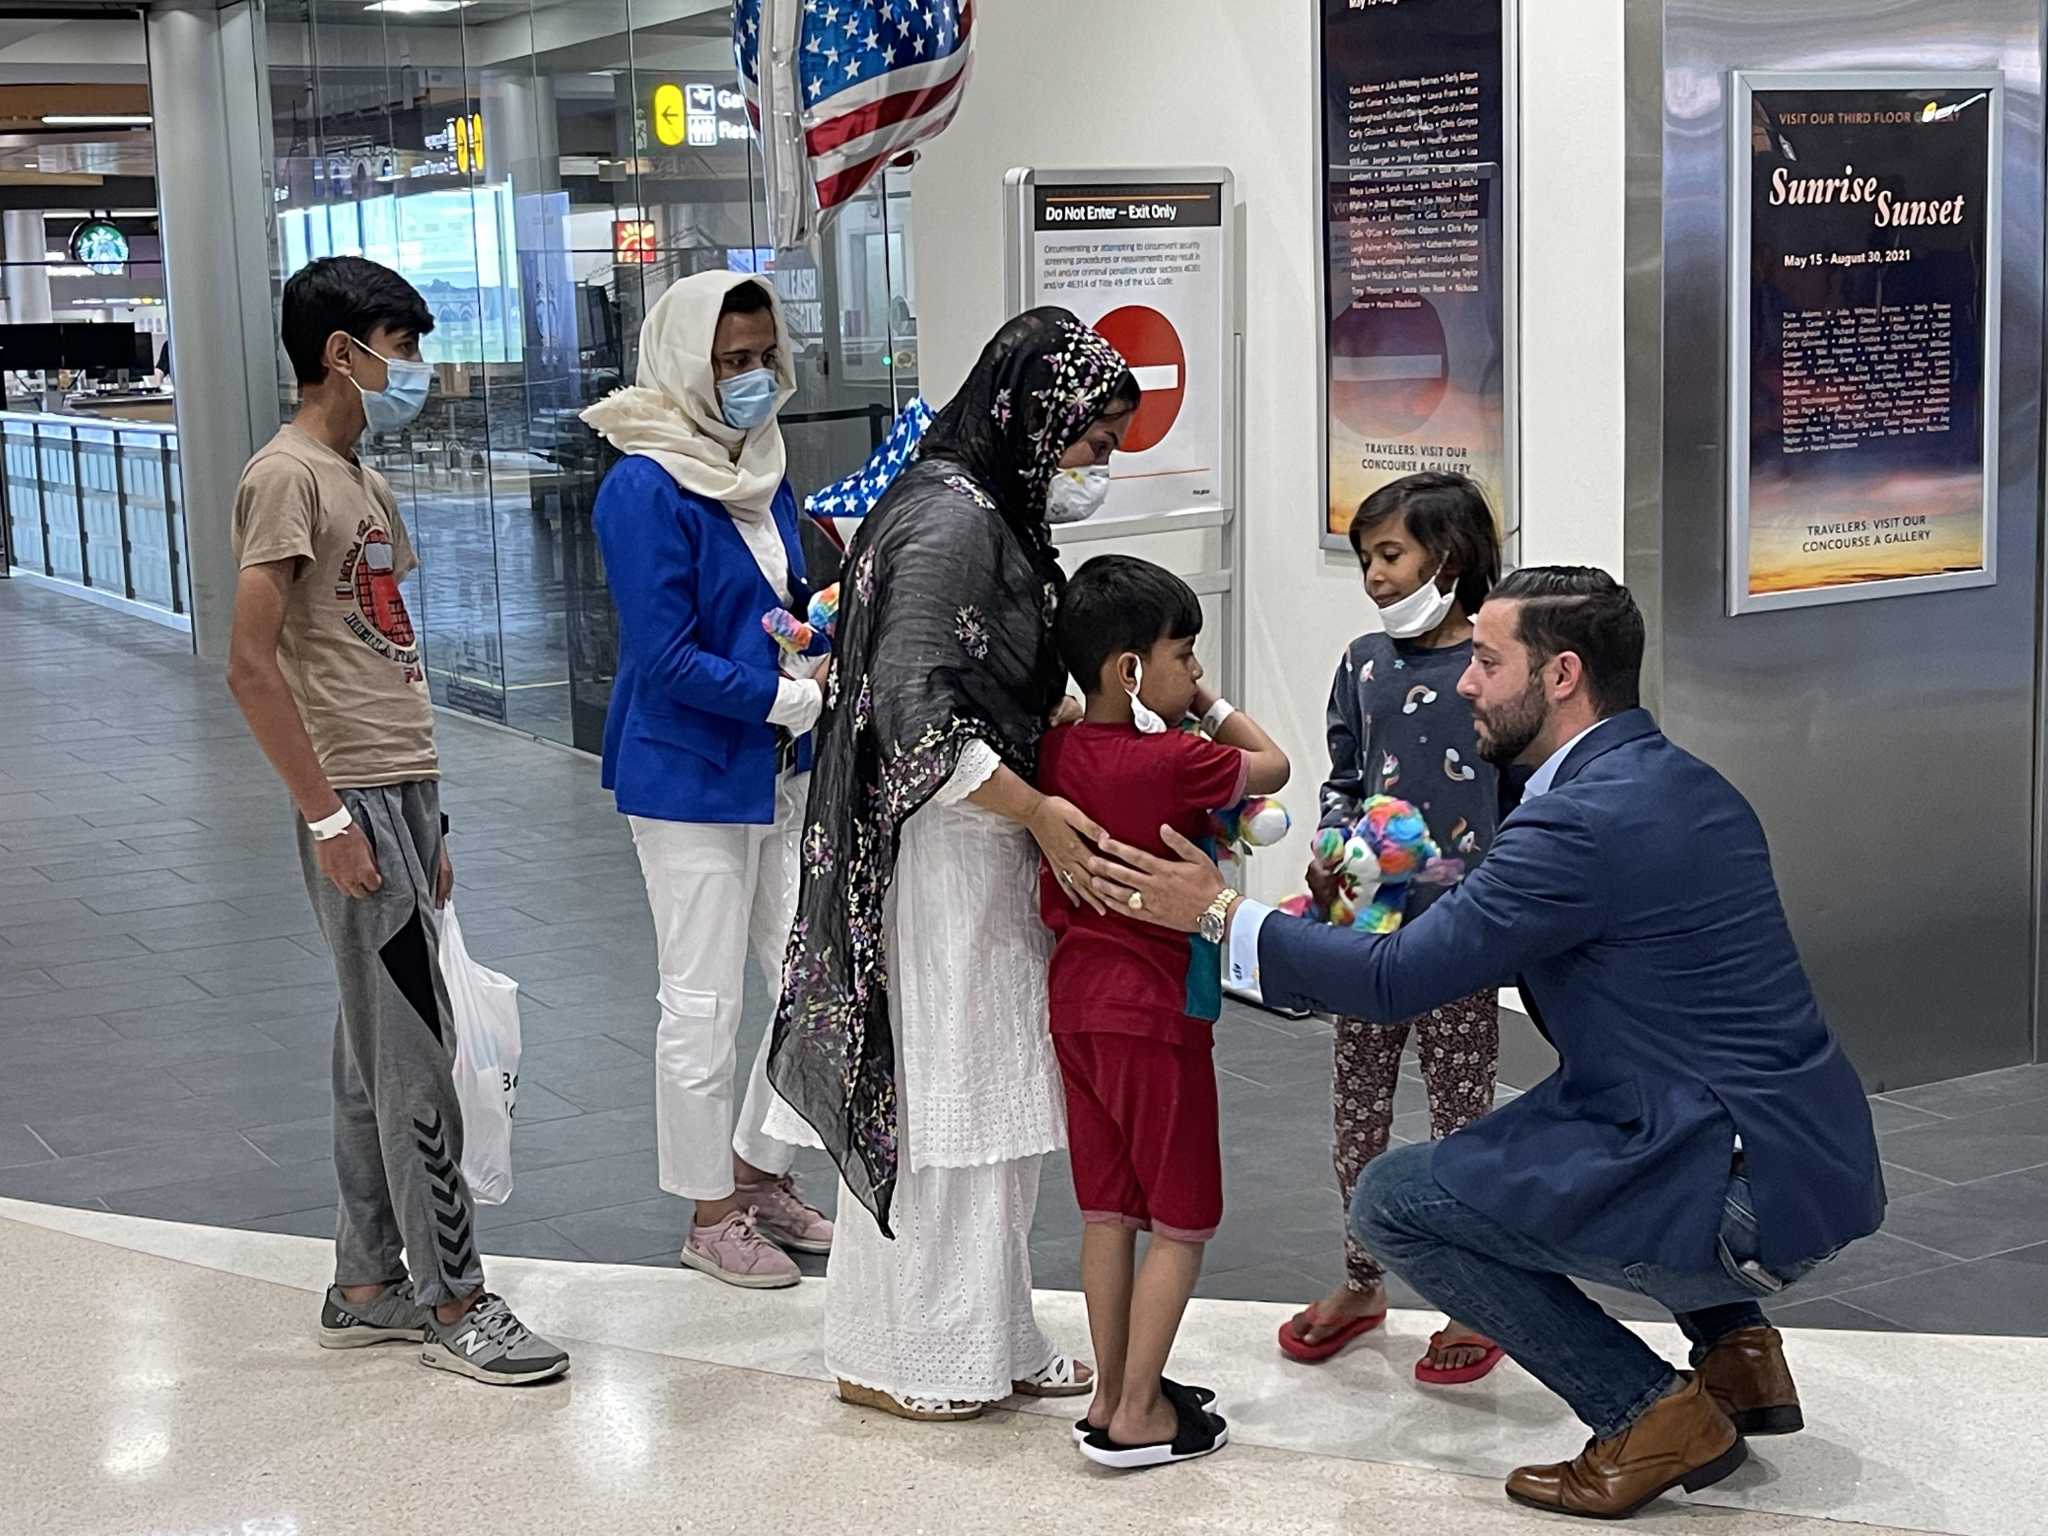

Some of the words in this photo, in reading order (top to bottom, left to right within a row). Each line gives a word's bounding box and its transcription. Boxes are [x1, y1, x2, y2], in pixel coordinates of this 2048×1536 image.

[1779, 113, 1807, 124] VISIT
[1810, 113, 1834, 124] OUR
[1838, 113, 1870, 124] THIRD
[1874, 112, 1910, 123] FLOOR
[1769, 165, 1877, 206] Sunrise
[1046, 207, 1062, 220] Do
[1064, 206, 1085, 220] Not
[1087, 206, 1117, 220] Enter
[1128, 205, 1150, 219] Exit
[1151, 204, 1176, 220] Only
[1875, 190, 1965, 227] Sunset
[1784, 254, 1807, 269] May
[1810, 252, 1822, 265] 15
[1830, 250, 1866, 266] August
[1868, 250, 1883, 264] 30,
[1886, 250, 1910, 262] 2021
[1420, 446, 1443, 456] VISIT
[1447, 447, 1467, 458] OUR
[1362, 459, 1417, 472] CONCOURSE
[1421, 462, 1426, 472] A
[1429, 463, 1472, 474] GALLERY
[1872, 517, 1900, 530] VISIT
[1903, 515, 1926, 526] OUR
[1802, 535, 1870, 553] CONCOURSE
[1874, 535, 1881, 545] A
[1885, 530, 1931, 544] GALLERY
